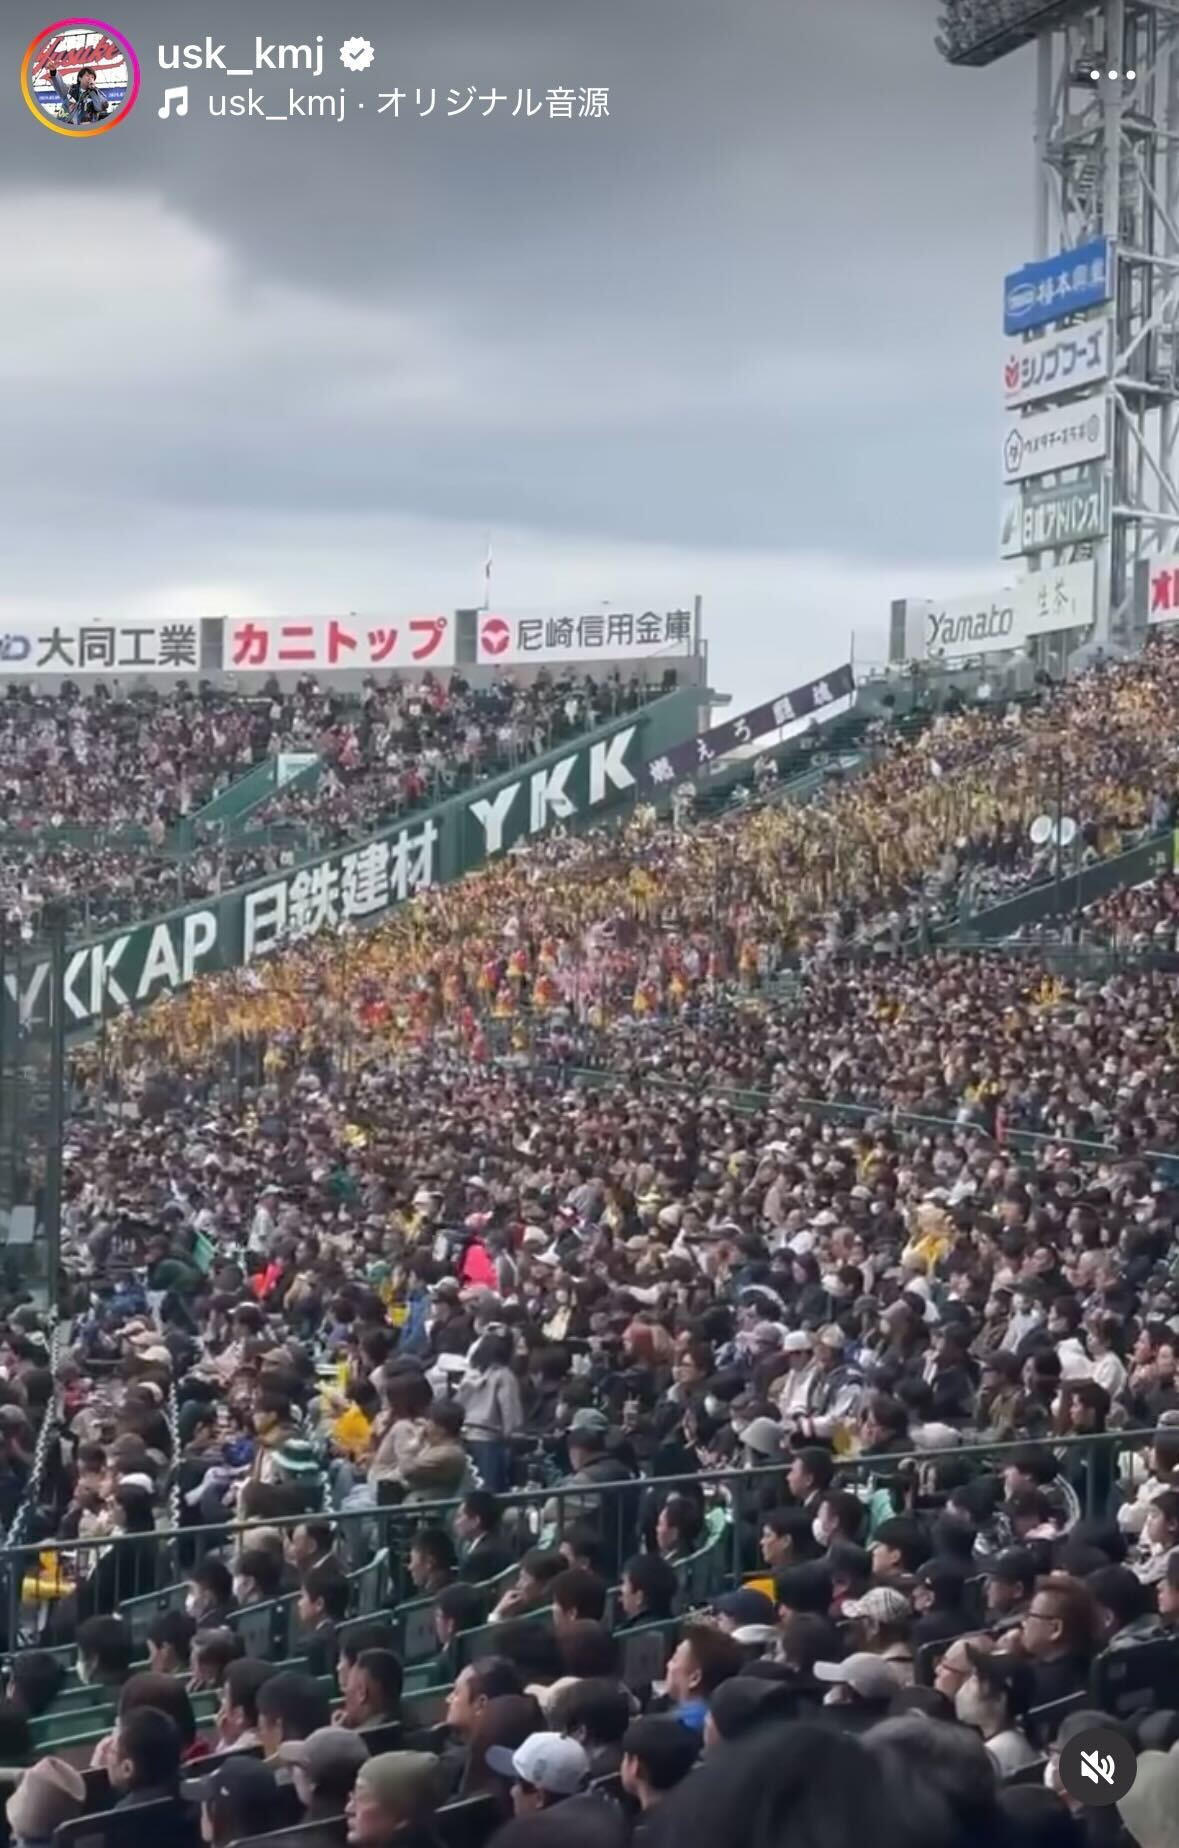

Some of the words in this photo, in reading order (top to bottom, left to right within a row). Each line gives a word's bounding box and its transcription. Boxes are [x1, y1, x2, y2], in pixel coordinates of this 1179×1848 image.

[36, 624, 196, 668] 大同工業
[232, 616, 448, 664] カニトップ
[516, 609, 691, 651] 尼崎信用金庫
[926, 603, 1014, 648] Yamato
[469, 726, 637, 854] YKK
[243, 818, 438, 966] 日鉄建材
[136, 911, 218, 999] AP
